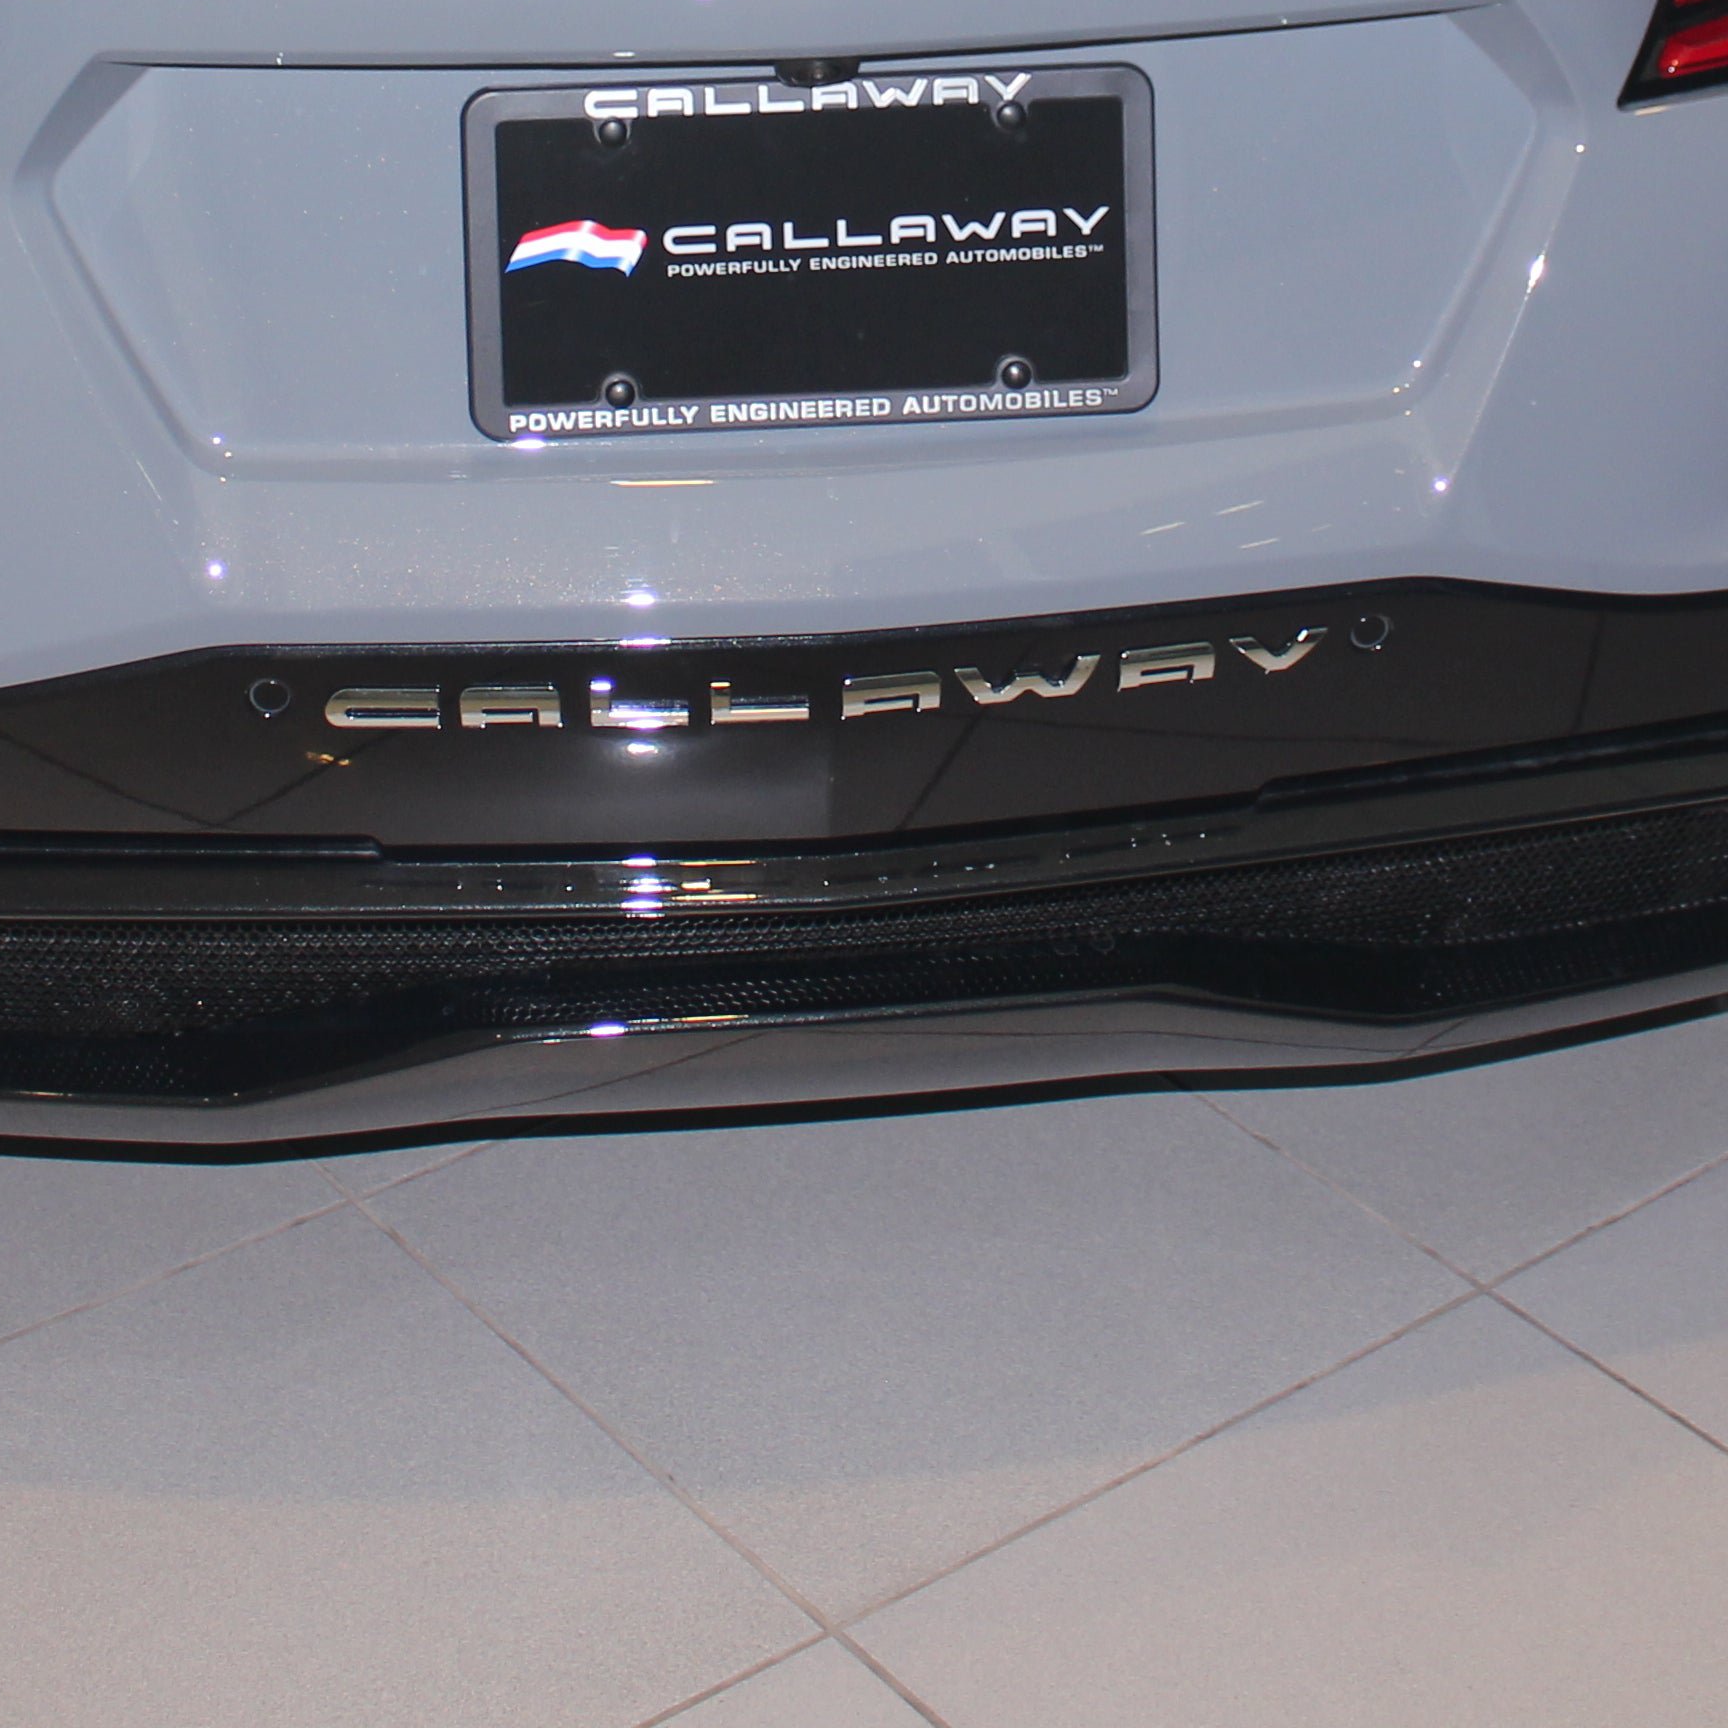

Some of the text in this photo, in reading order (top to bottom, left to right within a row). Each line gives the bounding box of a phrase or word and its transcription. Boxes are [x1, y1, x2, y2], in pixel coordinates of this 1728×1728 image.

[583, 72, 1032, 119] CALLAWAY
[662, 206, 1110, 255] CALLAWAY
[667, 258, 802, 277] POWERFULLY
[809, 252, 938, 271] ENGINEERED
[509, 405, 699, 433] POWERFULLY
[710, 397, 892, 423] ENGINEERED
[323, 627, 1328, 730] CALLAWAY
